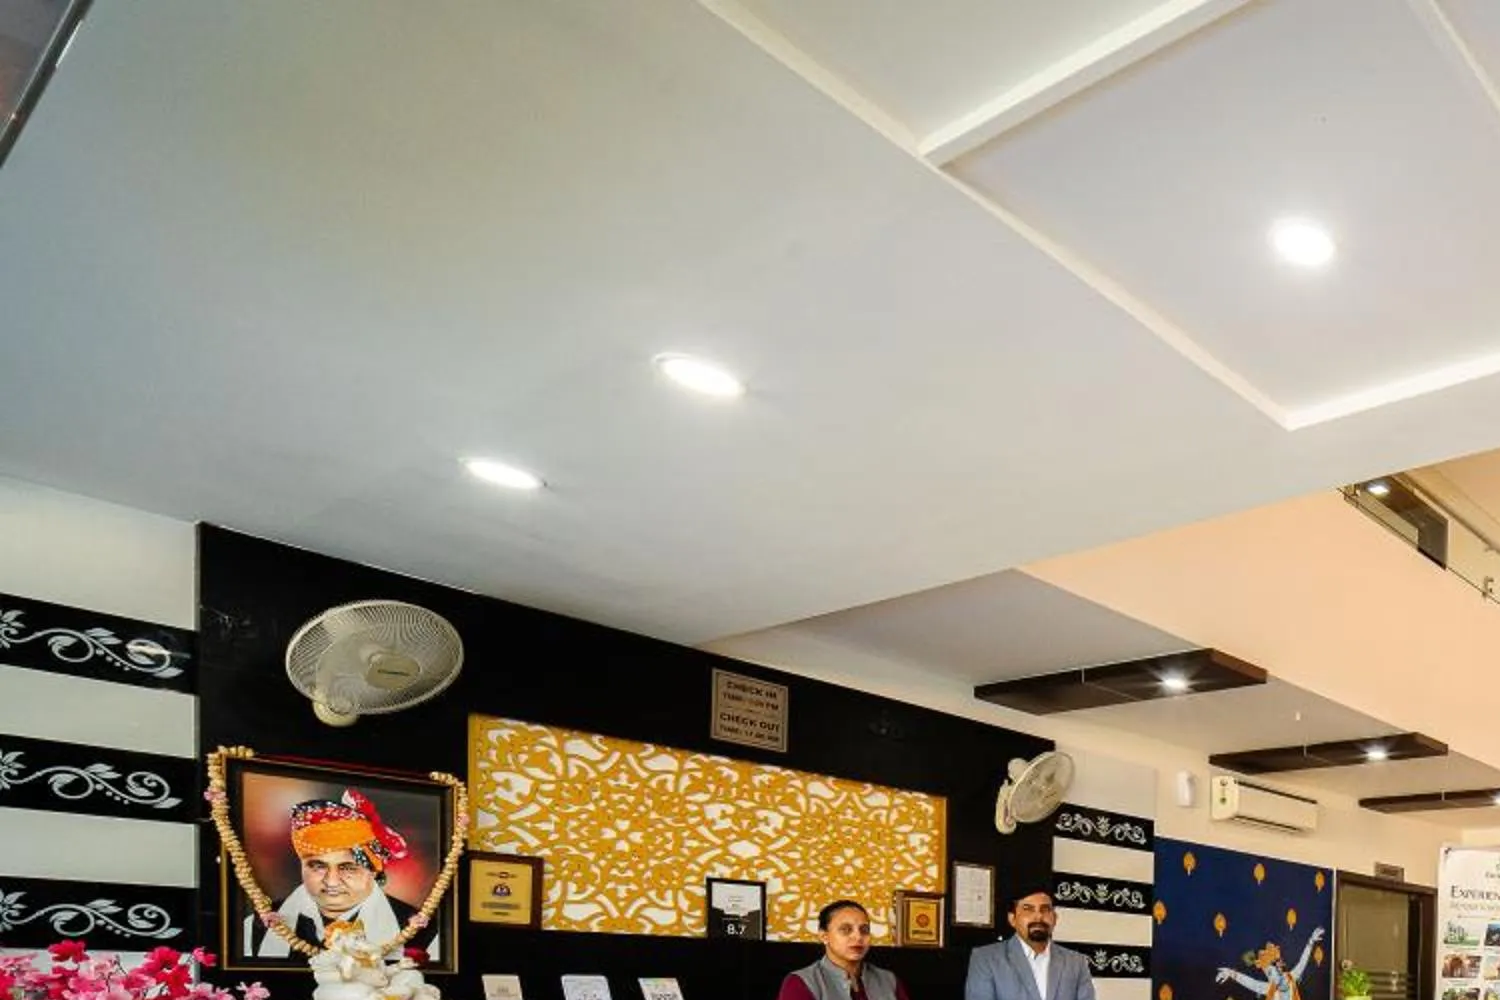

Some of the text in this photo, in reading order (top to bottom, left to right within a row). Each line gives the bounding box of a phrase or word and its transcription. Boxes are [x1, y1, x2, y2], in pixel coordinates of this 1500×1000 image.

[720, 712, 779, 732] CHECK OUT
[727, 923, 746, 935] 8.7
